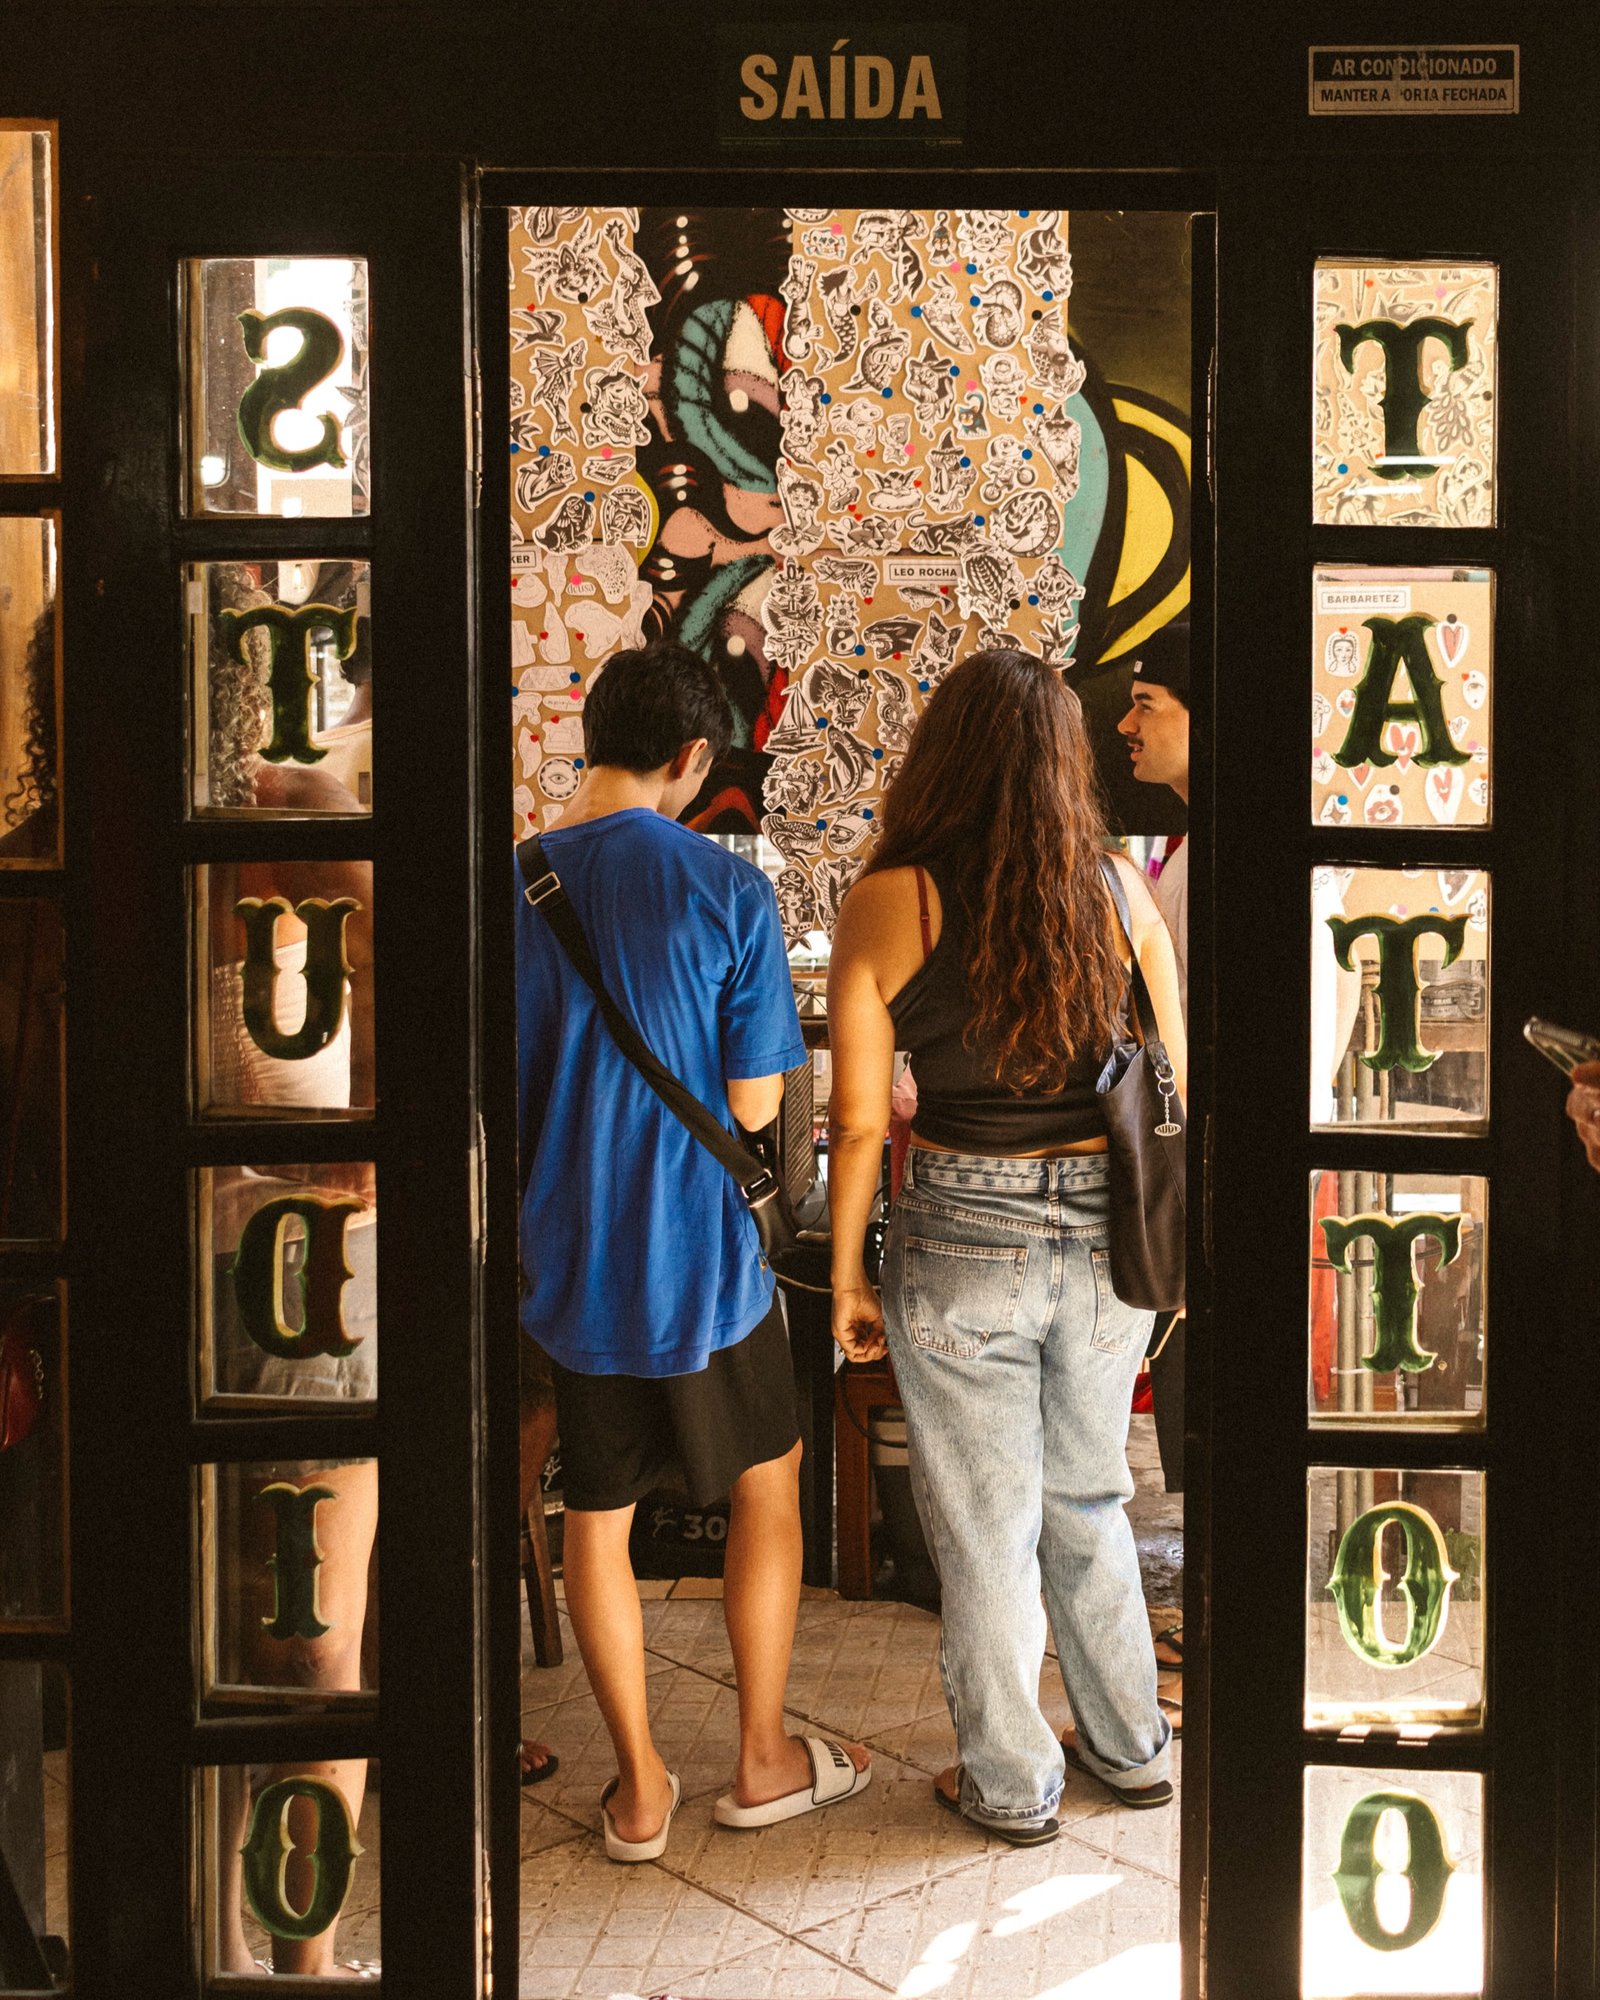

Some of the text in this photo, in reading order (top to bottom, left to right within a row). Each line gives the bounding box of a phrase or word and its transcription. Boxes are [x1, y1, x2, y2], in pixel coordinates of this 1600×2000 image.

[1332, 57, 1497, 76] AR CONDICIONADO
[740, 38, 942, 120] SAÍDA
[1321, 88, 1507, 102] MANTER A ORTA FECHADA
[894, 568, 957, 577] LEO ROCHA
[1327, 594, 1400, 604] BARBARETEZ
